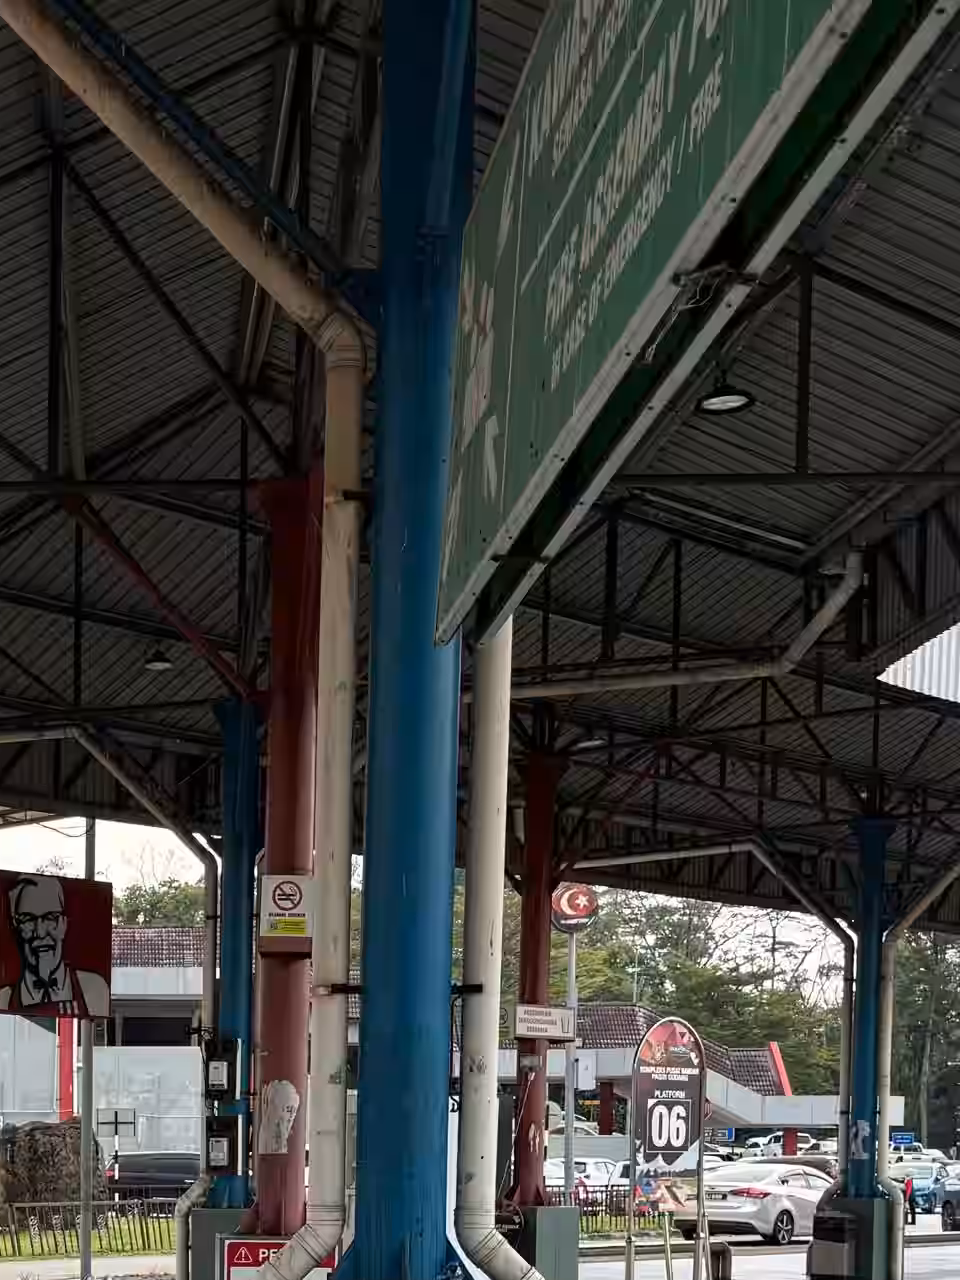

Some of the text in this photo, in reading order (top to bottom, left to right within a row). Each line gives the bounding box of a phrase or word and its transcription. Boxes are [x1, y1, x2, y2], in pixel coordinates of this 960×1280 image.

[552, 46, 594, 176] SEMASA
[544, 226, 577, 344] FIRE
[580, 14, 686, 270] ASSEMBLY
[550, 52, 724, 394] IN CASE OF EMERGENCY / FIRE
[651, 1105, 686, 1147] 06
[655, 1090, 685, 1098] PLATFORM
